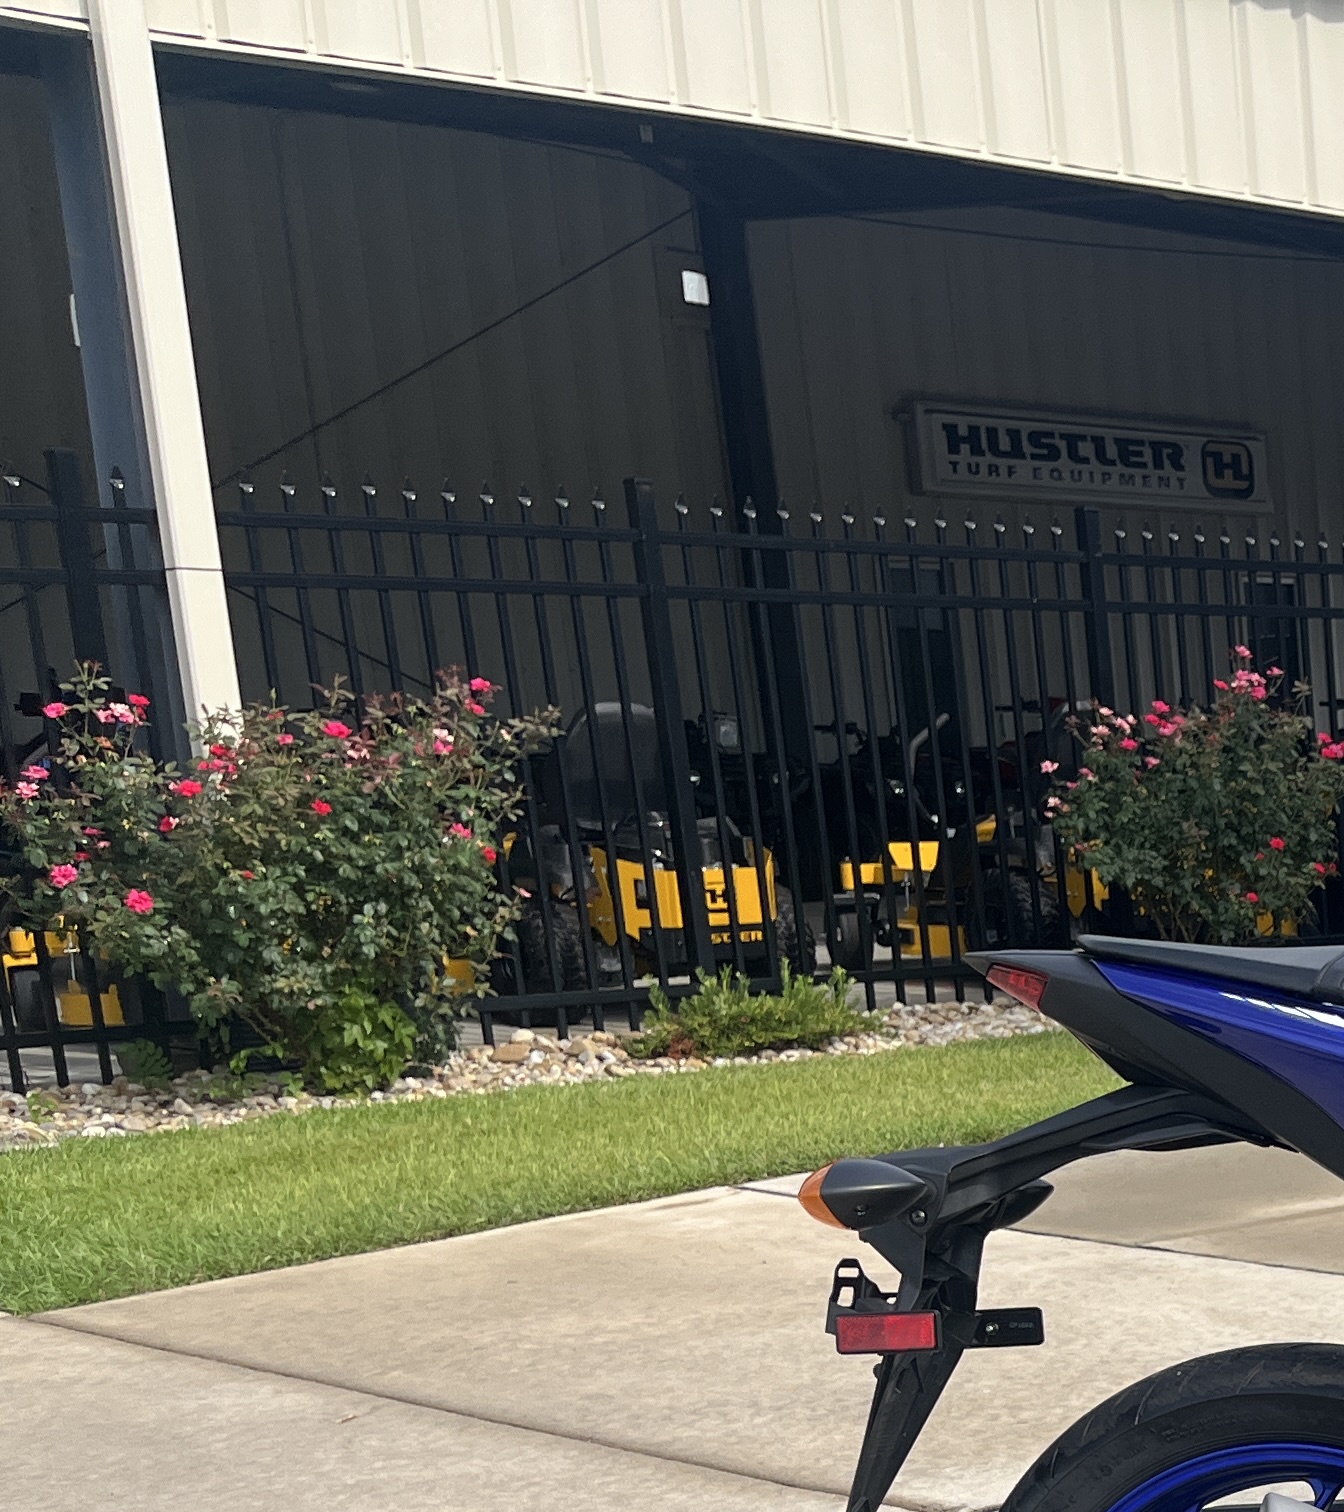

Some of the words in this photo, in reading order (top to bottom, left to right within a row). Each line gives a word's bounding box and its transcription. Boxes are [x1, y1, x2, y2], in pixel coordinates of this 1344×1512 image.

[942, 422, 1187, 473] HUSTLER
[948, 460, 1018, 480] TURF
[1032, 466, 1187, 491] EQUIPMENT
